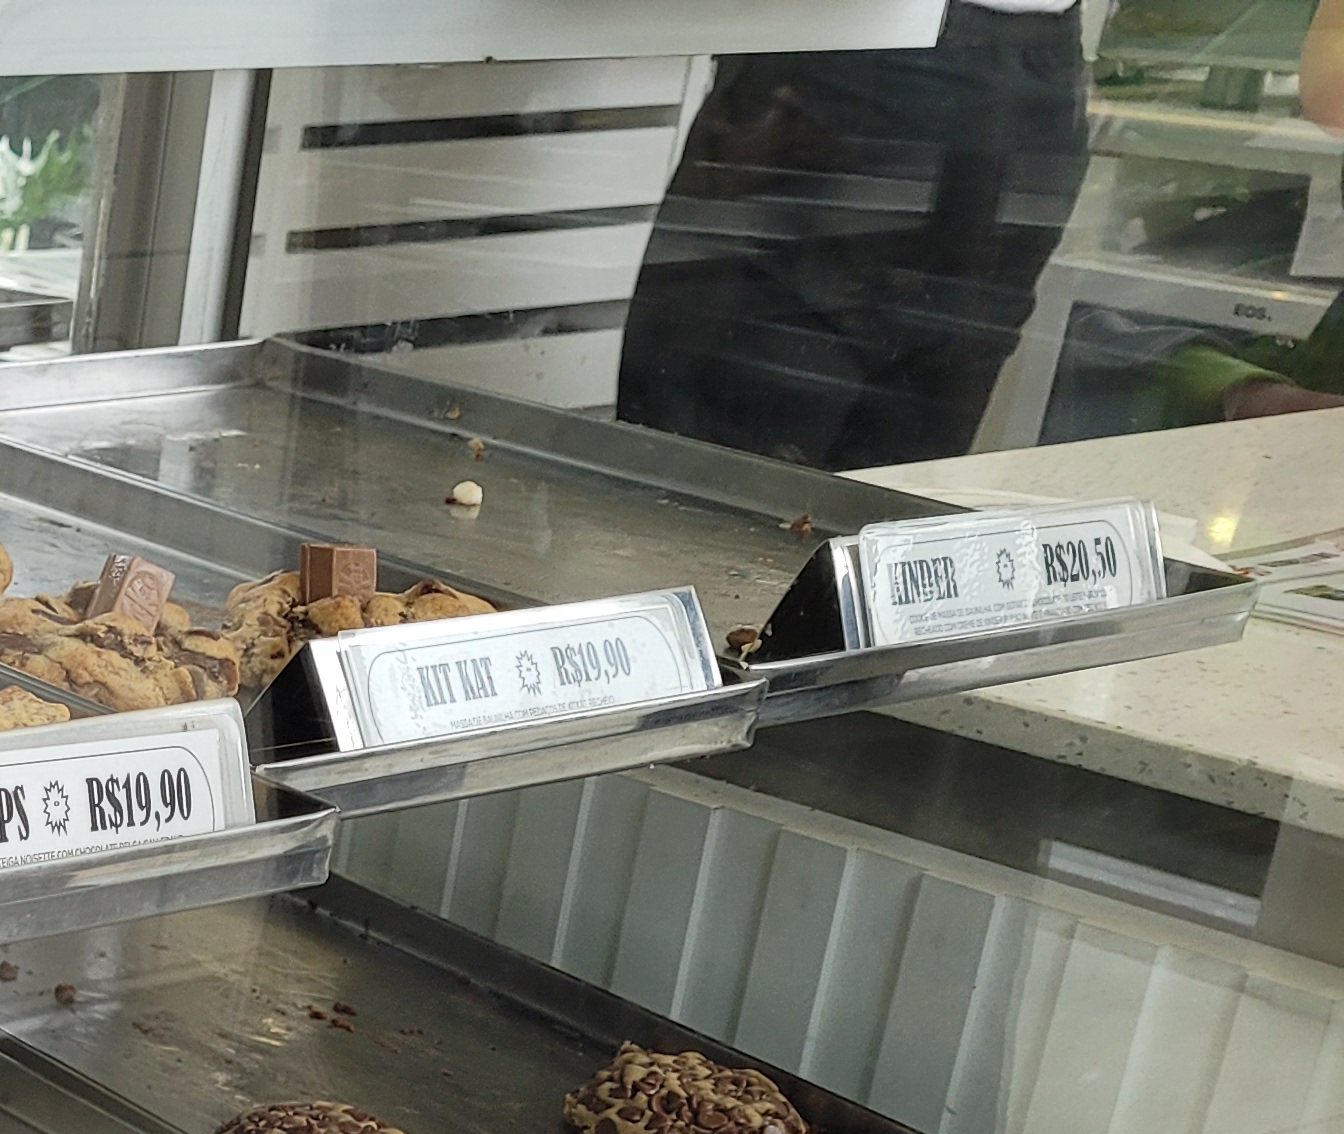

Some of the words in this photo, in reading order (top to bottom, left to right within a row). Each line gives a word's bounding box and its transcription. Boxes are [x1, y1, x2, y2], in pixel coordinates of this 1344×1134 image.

[1042, 536, 1116, 586] R$20,50
[416, 662, 456, 708] KIT
[456, 656, 497, 702] KAT
[550, 636, 630, 686] R$19,90
[85, 766, 191, 834] R$19,90
[20, 850, 54, 864] NOISETTE
